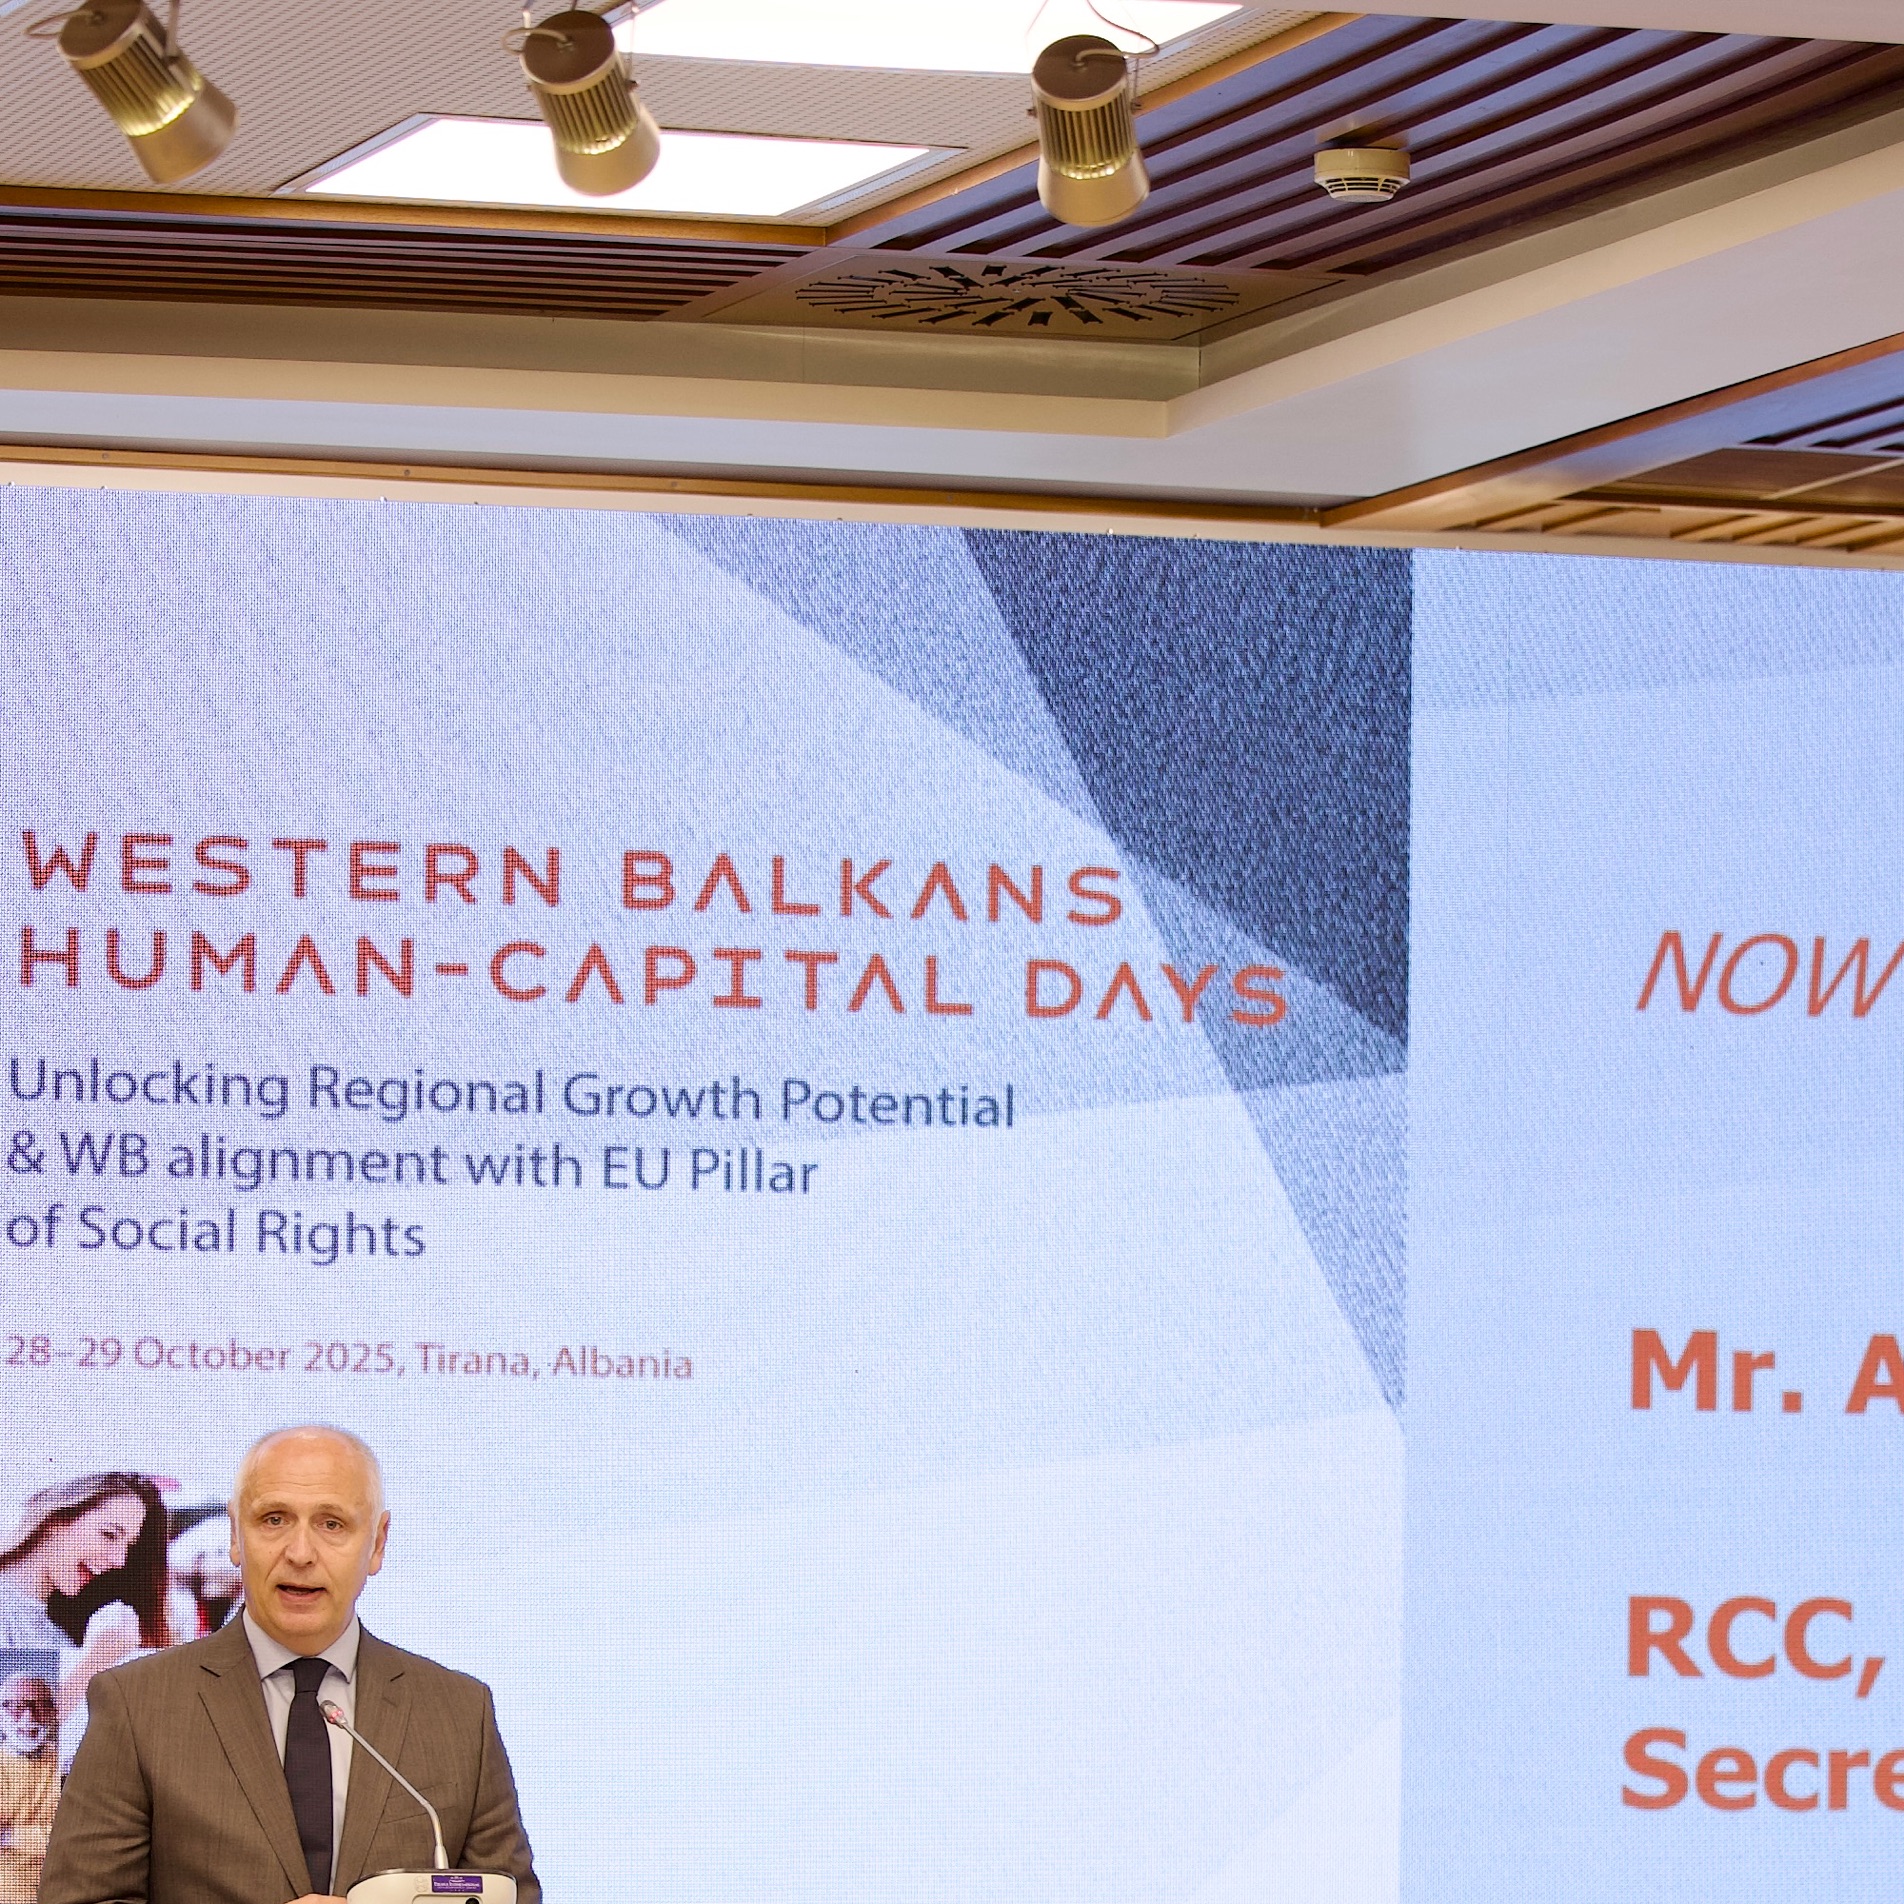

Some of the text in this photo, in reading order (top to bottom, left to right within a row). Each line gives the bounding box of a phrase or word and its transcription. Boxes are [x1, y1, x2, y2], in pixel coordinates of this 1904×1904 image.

[21, 831, 1124, 927] WESTERN BALKANS
[19, 926, 1289, 1029] HUMAN-CAPITAL DAYS
[9, 1057, 1016, 1130] Unlocking Regional Growth Potential
[6, 1131, 819, 1197] & WB alignment with EU Pillar
[5, 1203, 427, 1266] of Social Rights
[132, 1335, 293, 1373] October
[303, 1340, 407, 1378] 2025,
[414, 1341, 539, 1381] Tirana,
[552, 1344, 696, 1382] Albania
[1629, 1328, 1802, 1415] Mr.
[1625, 1596, 1888, 1699] RCC,
